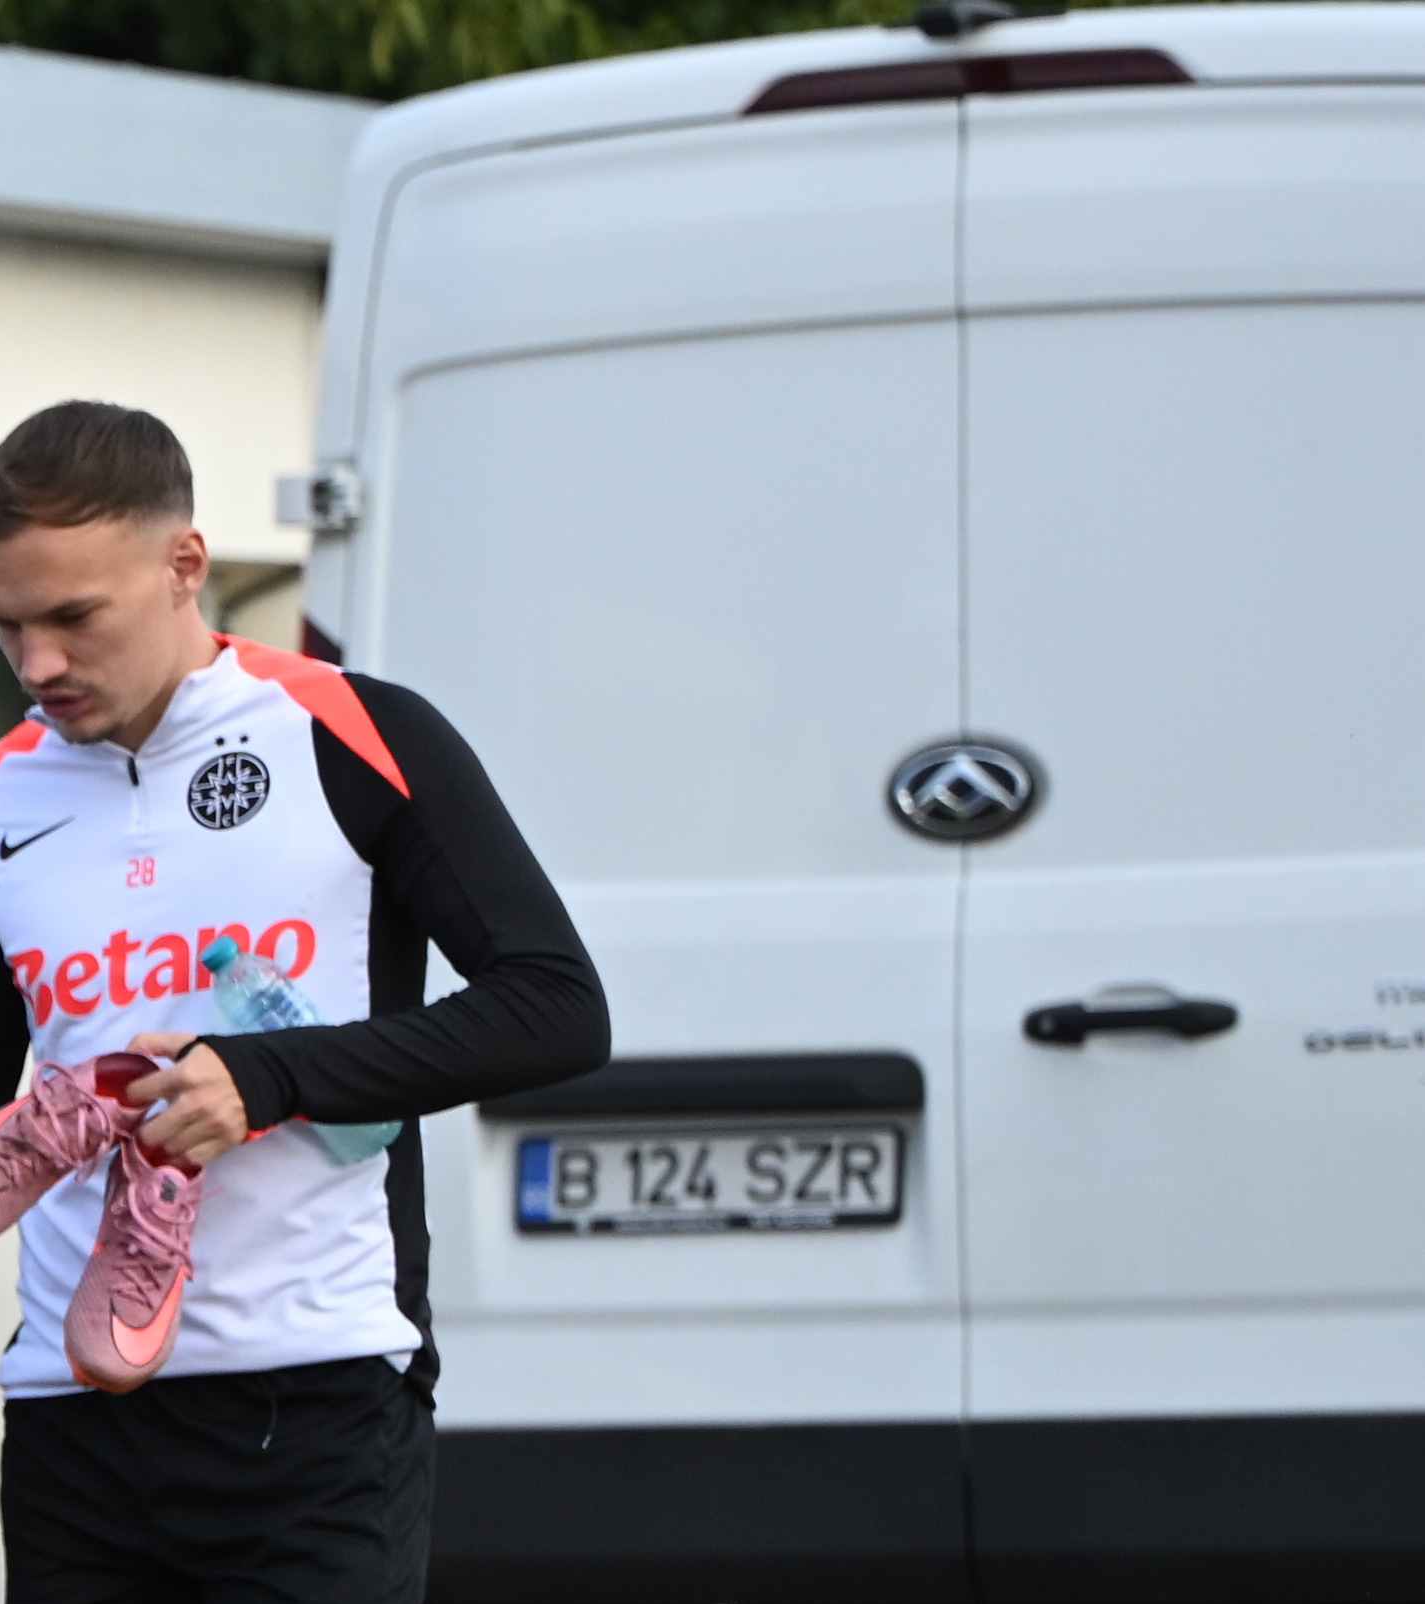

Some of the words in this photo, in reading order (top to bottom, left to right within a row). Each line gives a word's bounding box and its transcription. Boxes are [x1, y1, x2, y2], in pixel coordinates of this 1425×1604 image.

[127, 857, 156, 888] 28
[557, 1146, 597, 1208] B
[625, 1144, 716, 1206] 124
[746, 1140, 882, 1204] SZR
